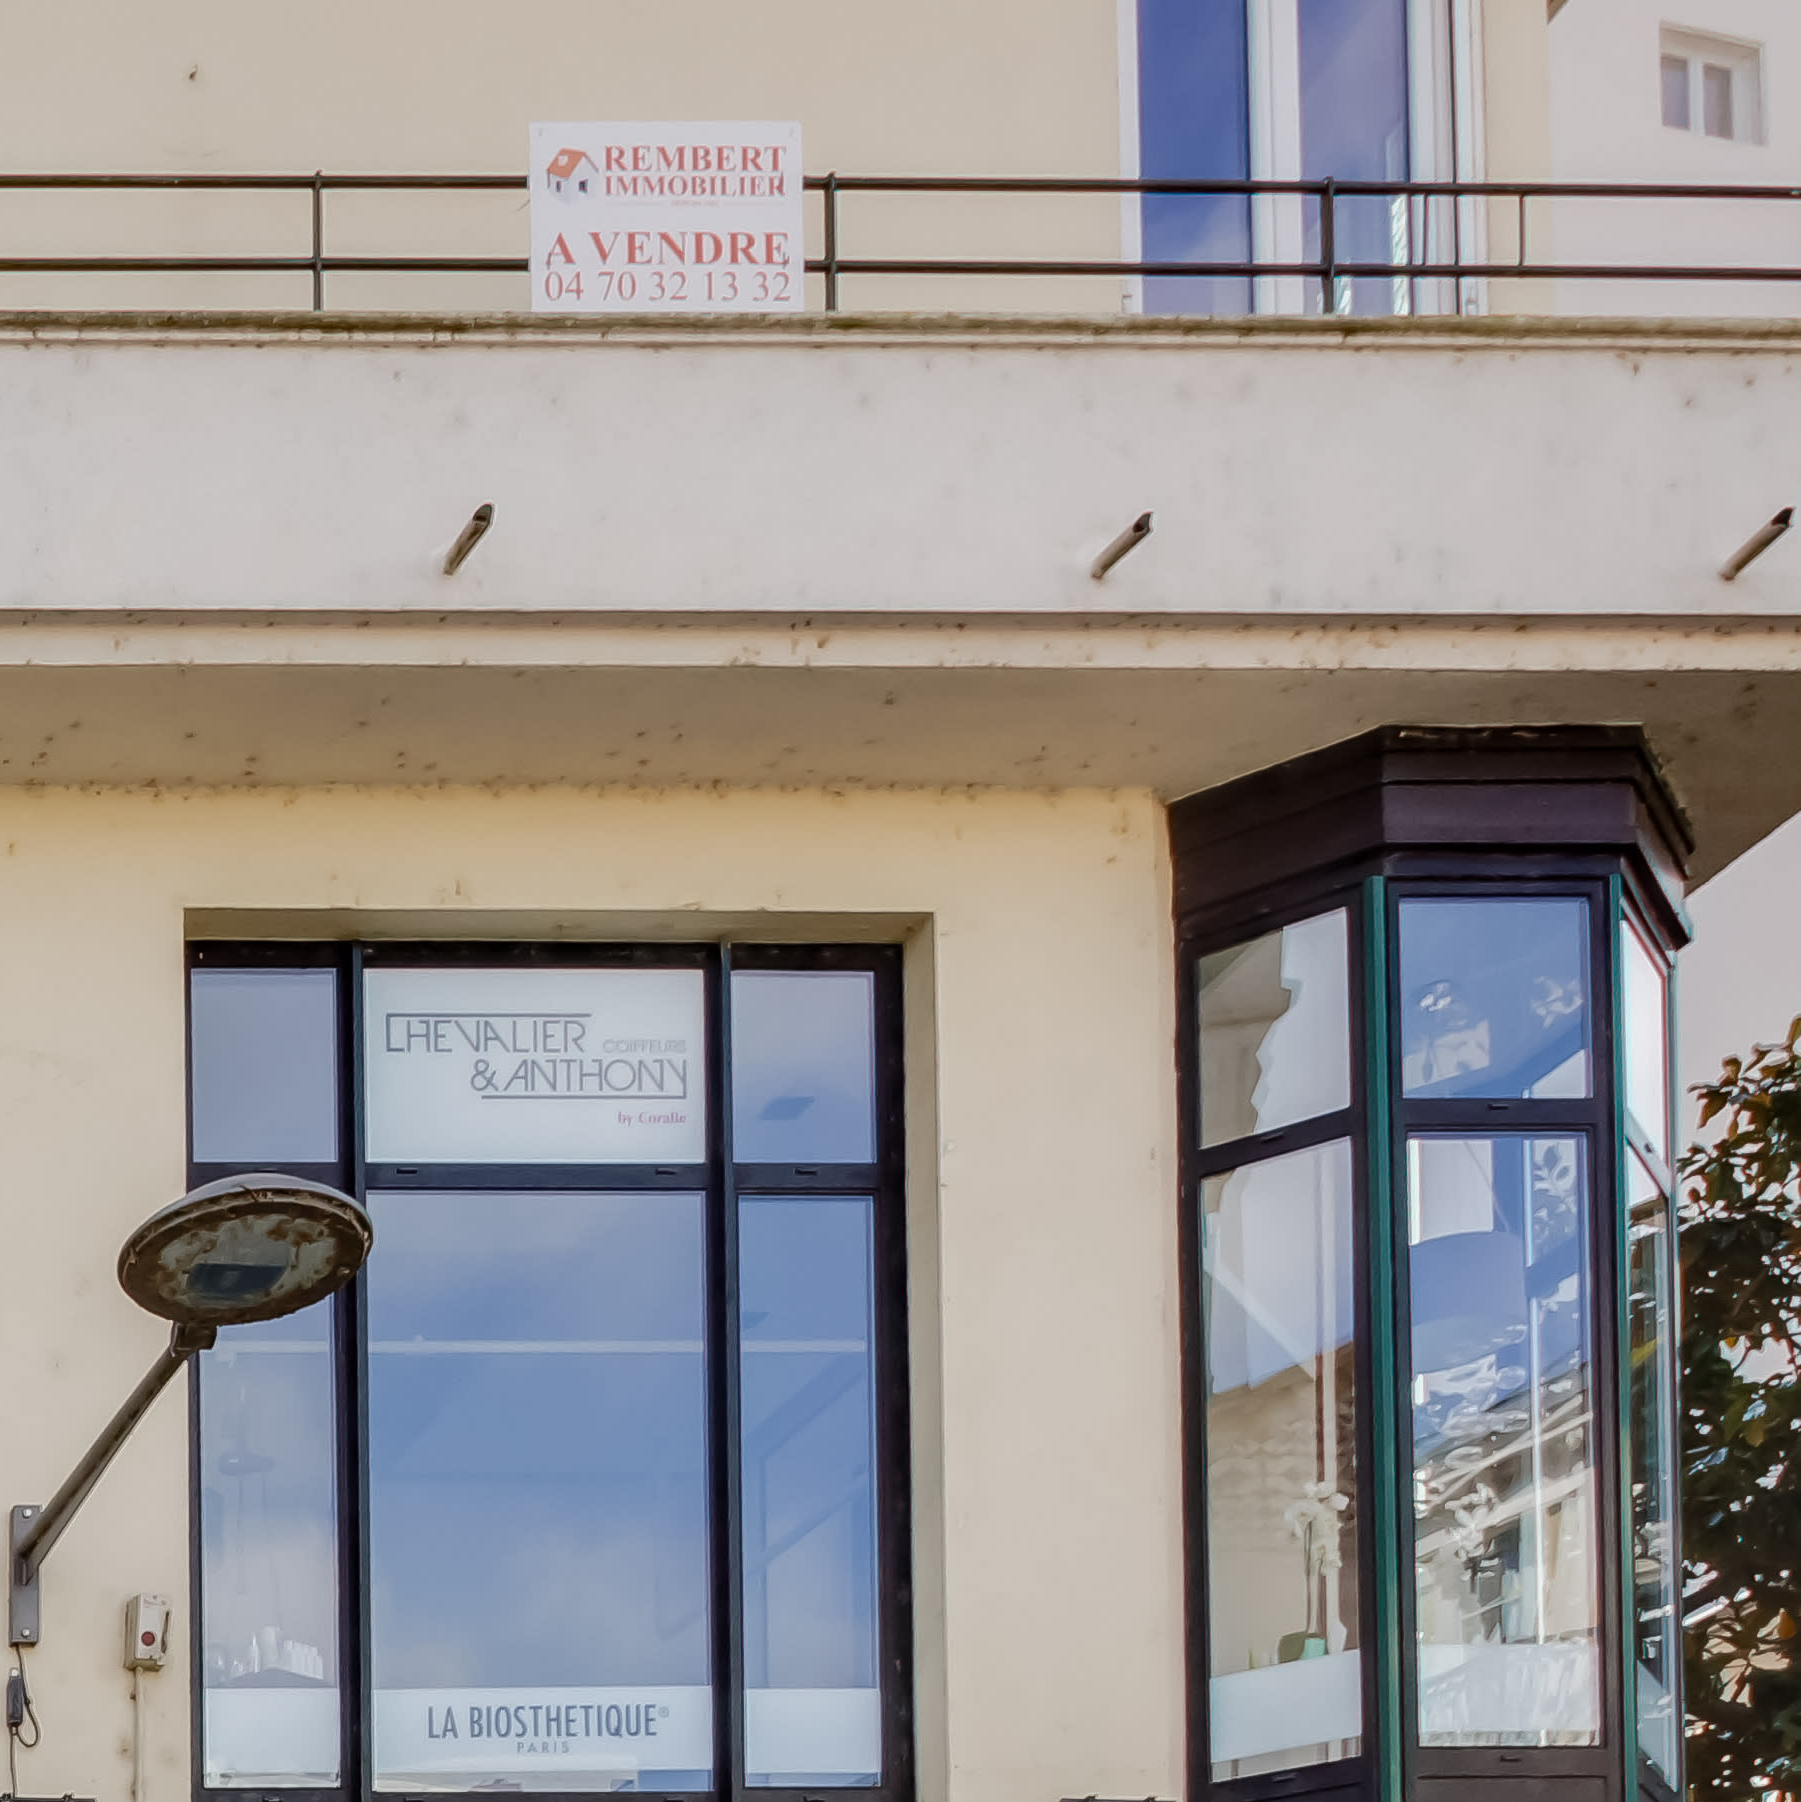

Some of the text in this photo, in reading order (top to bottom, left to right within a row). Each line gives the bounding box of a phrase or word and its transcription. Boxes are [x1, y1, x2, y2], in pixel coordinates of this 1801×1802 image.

[604, 145, 787, 172] REMBERT
[604, 174, 787, 197] IMMOBILIER
[545, 231, 791, 266] A VENDRE
[544, 270, 791, 302] 04 70 32 13 32
[385, 1012, 687, 1054] CHEVALIER COIFFEURS
[503, 1057, 687, 1099] ANTHONY
[617, 1111, 634, 1127] by
[428, 1705, 459, 1739] LA
[516, 1741, 570, 1754] PARIS
